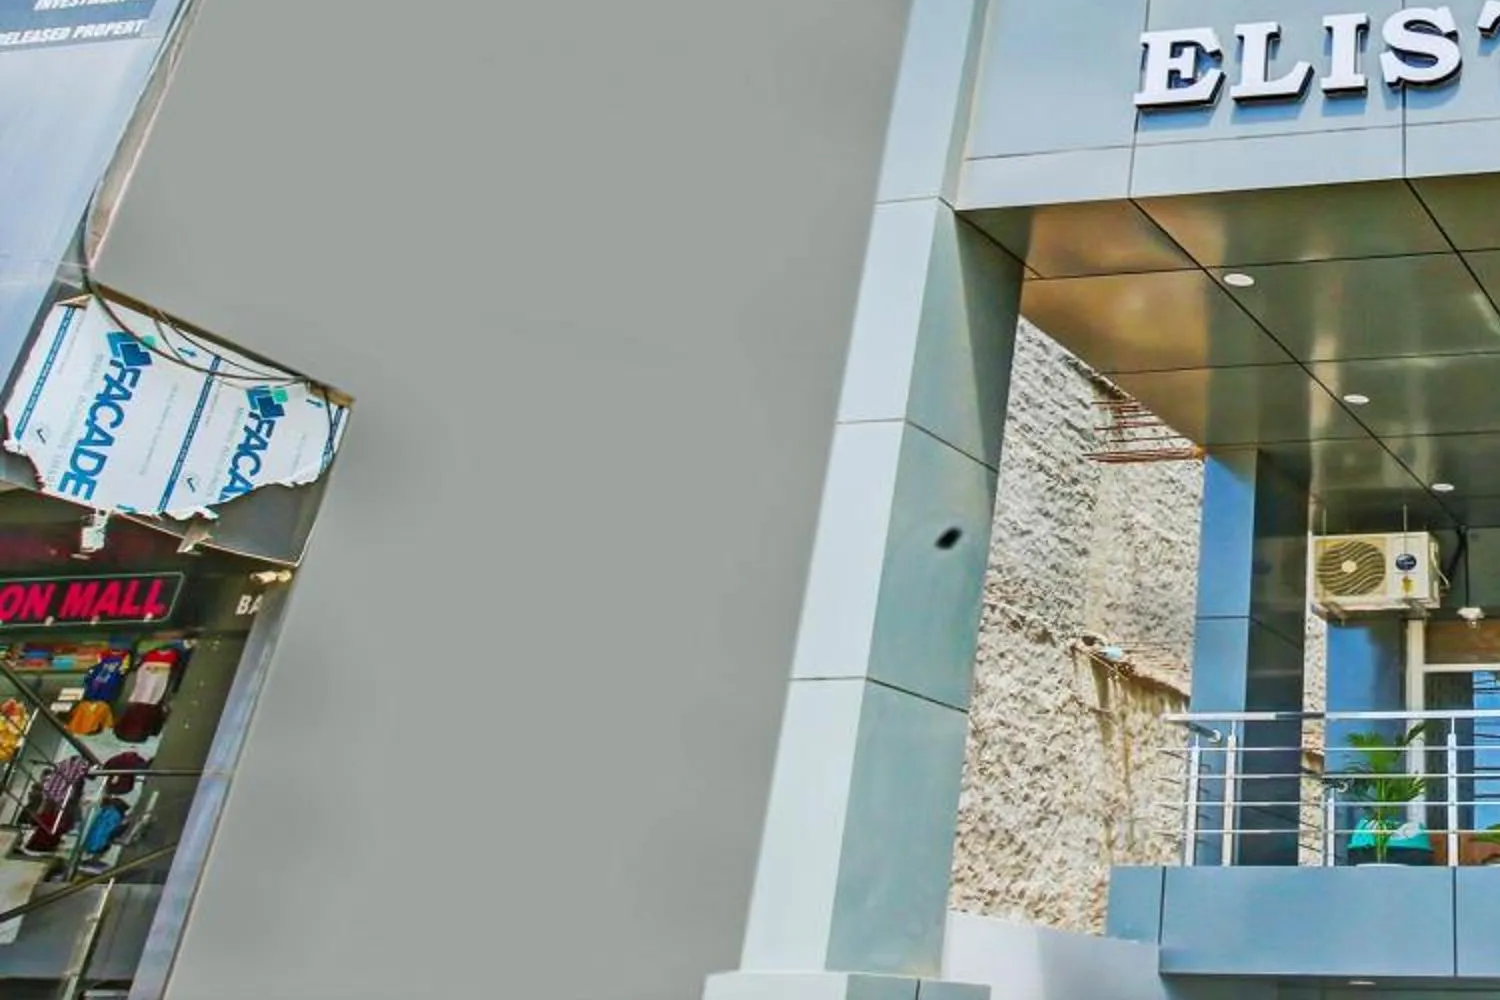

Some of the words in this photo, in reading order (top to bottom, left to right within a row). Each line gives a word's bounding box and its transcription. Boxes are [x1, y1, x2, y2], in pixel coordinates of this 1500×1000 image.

[57, 359, 141, 500] FACADE
[218, 412, 276, 501] FACA
[58, 578, 168, 619] MALL
